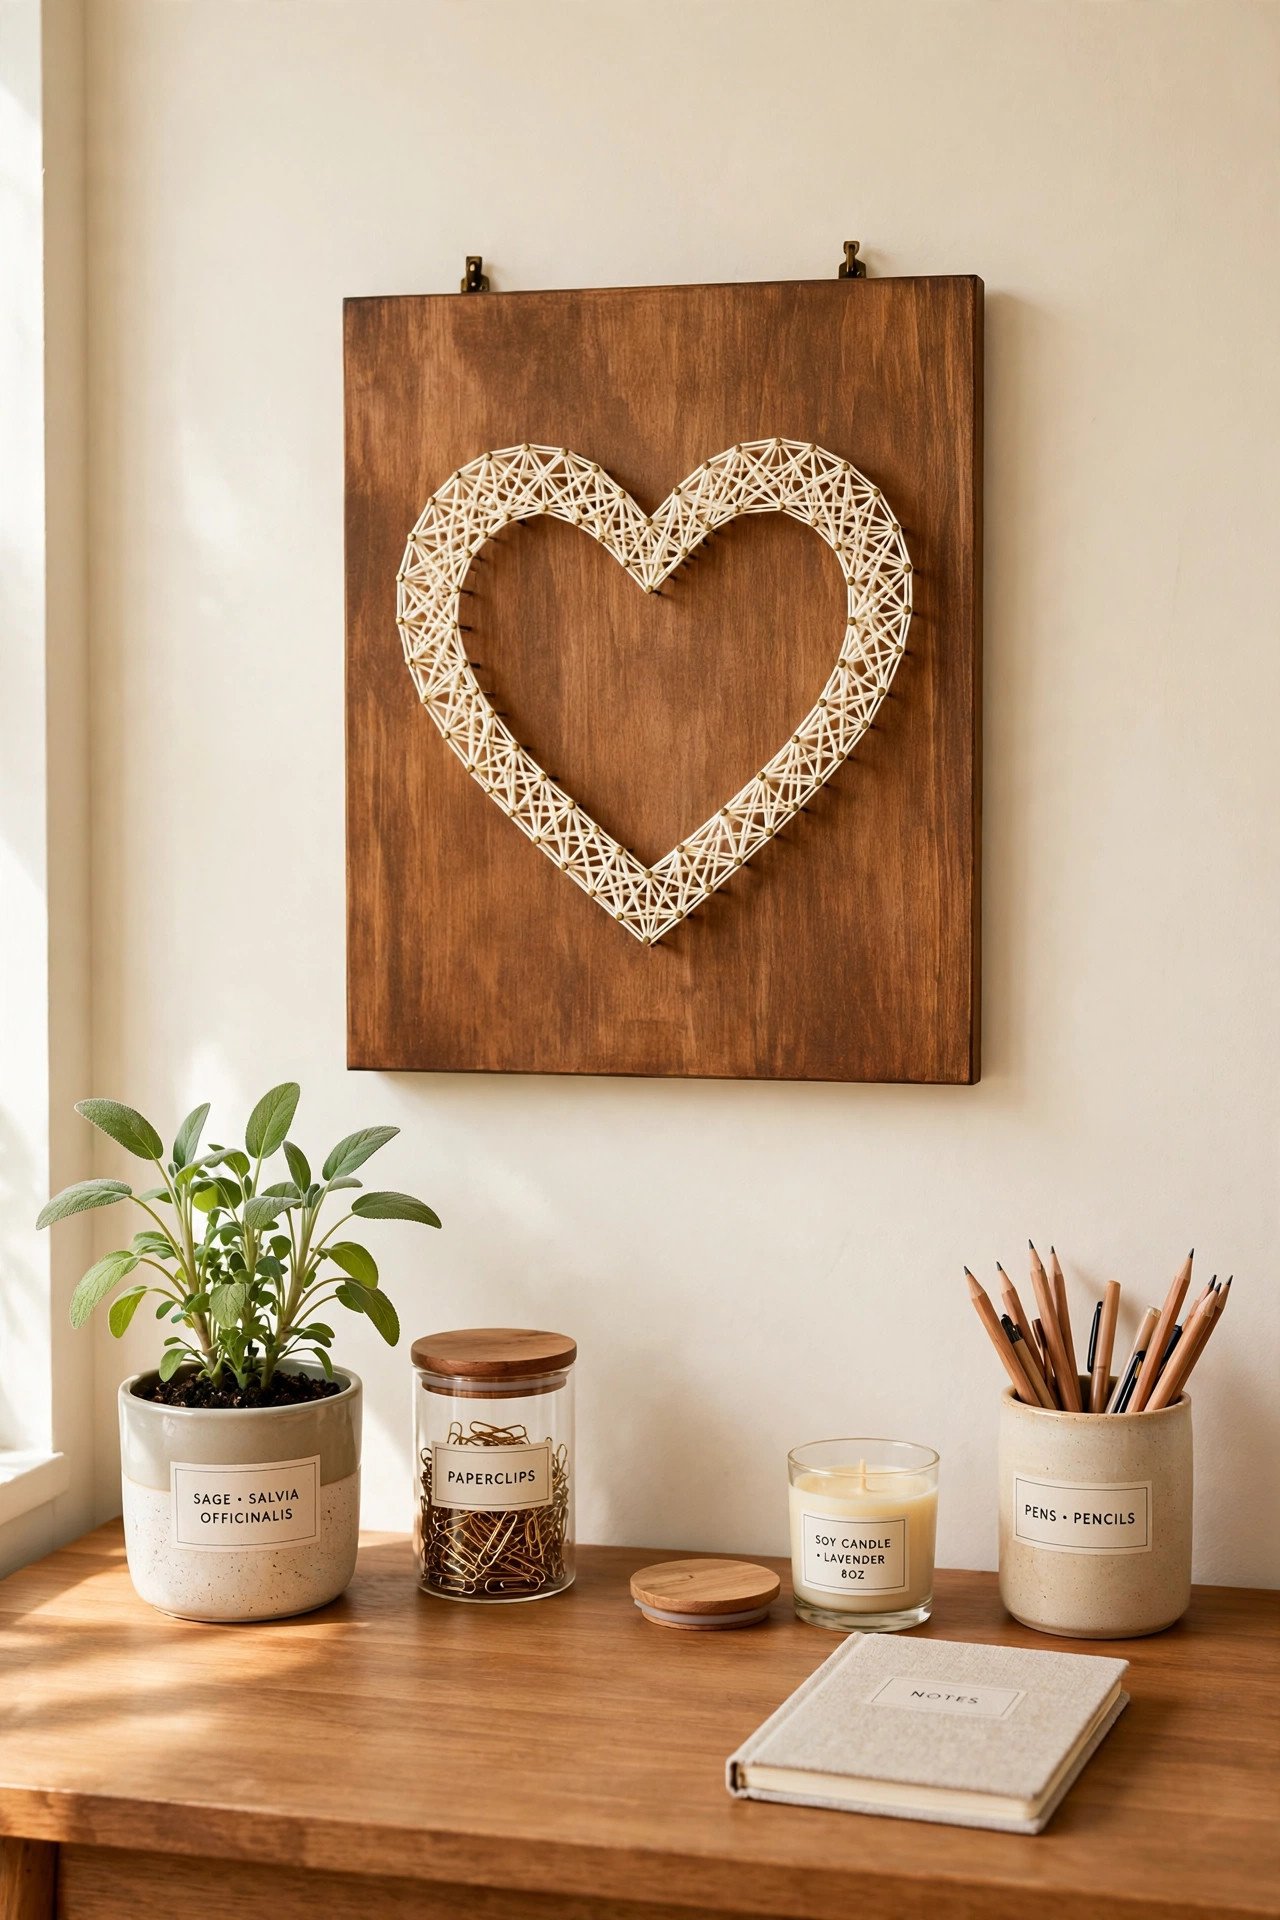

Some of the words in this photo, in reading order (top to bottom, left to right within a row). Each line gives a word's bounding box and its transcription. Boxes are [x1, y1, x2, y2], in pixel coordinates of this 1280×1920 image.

[448, 1470, 535, 1485] PAPERCLIPS
[193, 1493, 231, 1505] SAGE
[248, 1489, 299, 1504] SALVIA
[200, 1508, 293, 1524] OFFICINALIS
[1025, 1504, 1057, 1522] PENS
[1073, 1512, 1136, 1525] PENCILS
[815, 1535, 837, 1547] SOY
[841, 1538, 891, 1549] CANDLE
[824, 1552, 885, 1565] LAVENDER
[841, 1569, 865, 1580] 8OZ
[911, 1690, 979, 1704] NOTES
